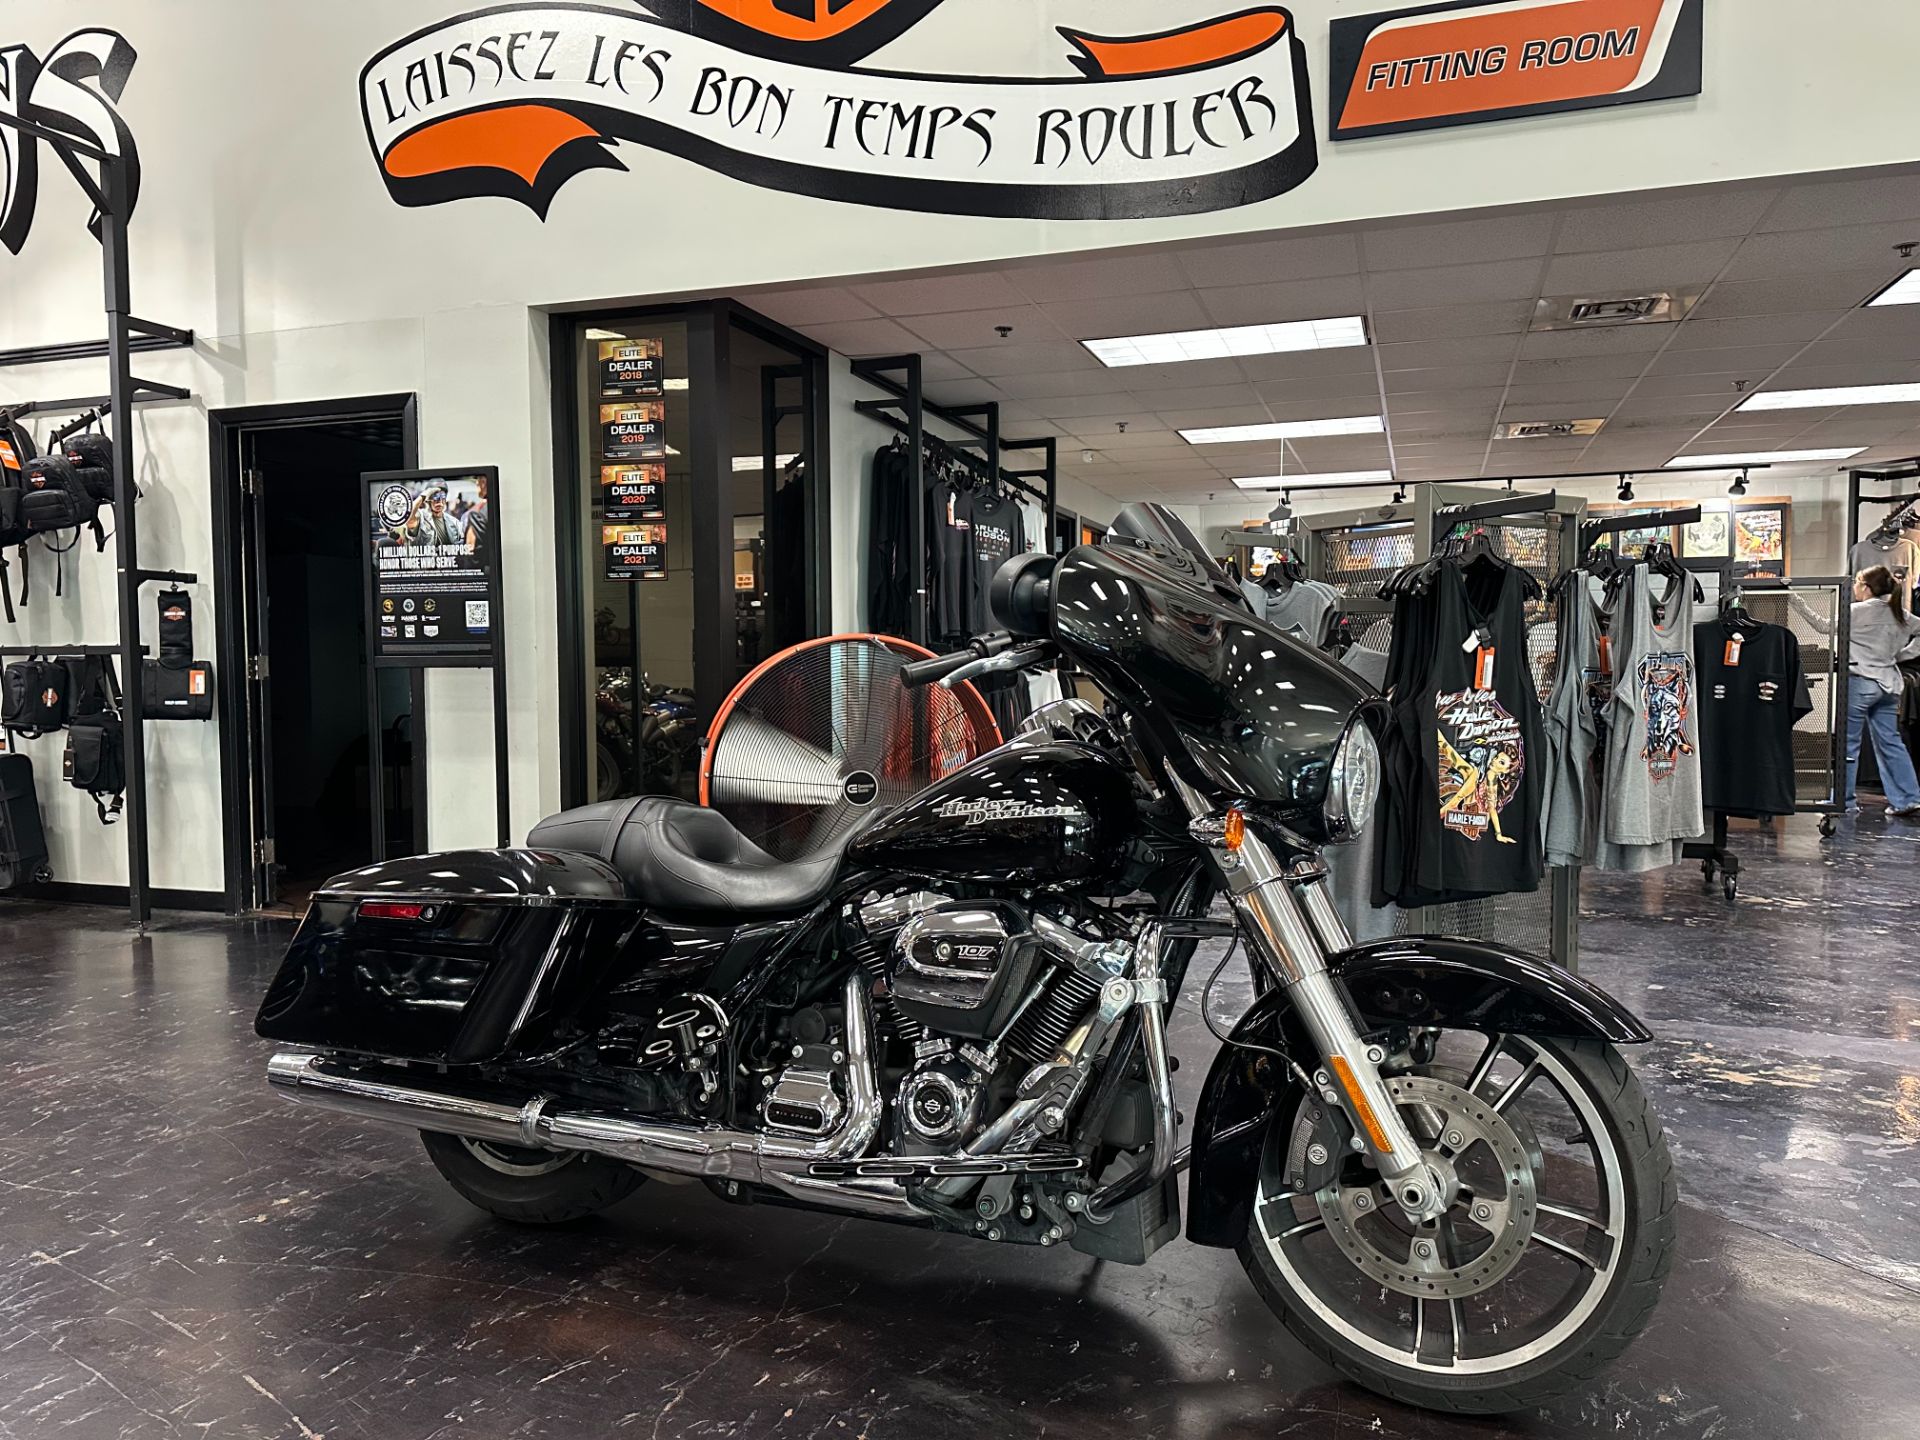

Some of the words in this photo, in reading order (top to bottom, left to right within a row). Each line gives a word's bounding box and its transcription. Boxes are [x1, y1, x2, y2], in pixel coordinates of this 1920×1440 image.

[1365, 46, 1507, 93] FITTING
[1519, 26, 1641, 72] ROOM
[377, 30, 562, 125] LAISSEZ
[585, 33, 673, 104] LES
[688, 65, 795, 140] BON
[824, 94, 998, 168] TEMPS
[1033, 75, 1277, 169] ROULER
[618, 348, 643, 358] ELITE
[608, 360, 653, 372] DEALER
[619, 371, 643, 380] 2018
[620, 412, 644, 421] ELITE
[610, 423, 655, 435] DEALER
[621, 434, 645, 443] 2019
[621, 473, 645, 482] ELITE
[611, 485, 656, 496] DEALER
[621, 495, 646, 504] 2020
[623, 534, 647, 542] ELITE
[612, 545, 657, 556] DEALER
[623, 555, 647, 564] 2021
[962, 804, 1082, 826] Davidson
[954, 945, 995, 957] 107
